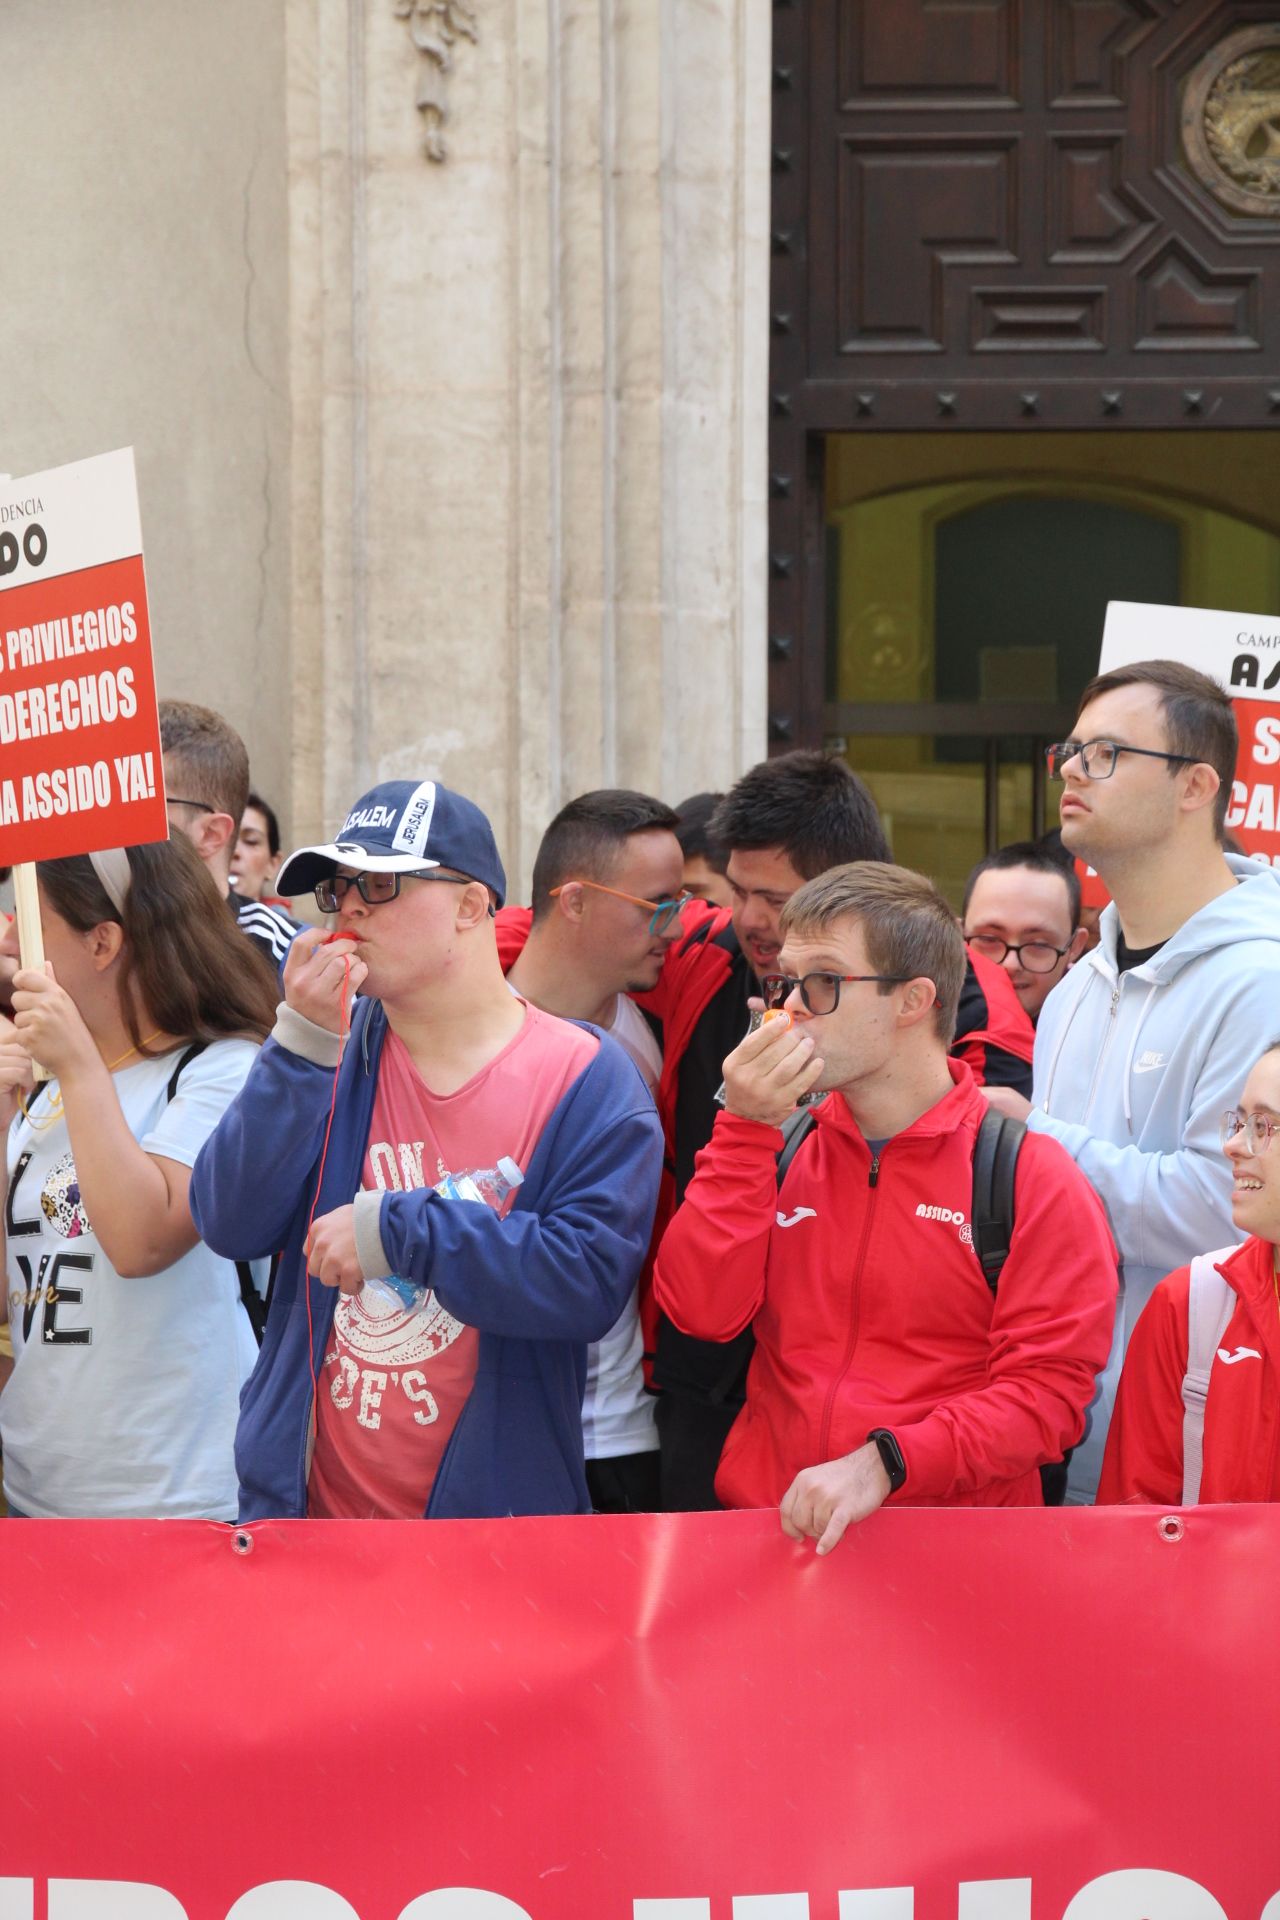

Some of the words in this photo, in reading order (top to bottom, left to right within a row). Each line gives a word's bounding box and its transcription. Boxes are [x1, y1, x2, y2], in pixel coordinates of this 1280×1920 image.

[0, 497, 44, 523] DENCIA
[0, 523, 48, 576] DO
[6, 601, 138, 671] PRIVILEGIOS
[0, 666, 138, 745] DERECHOS
[0, 779, 20, 827] A
[22, 760, 112, 823] ASSIDO
[113, 751, 156, 804] YA!
[1223, 780, 1280, 832] CA
[403, 798, 431, 845] JERUSALEM
[360, 1141, 426, 1192] ON
[915, 1203, 965, 1226] ASSIDO
